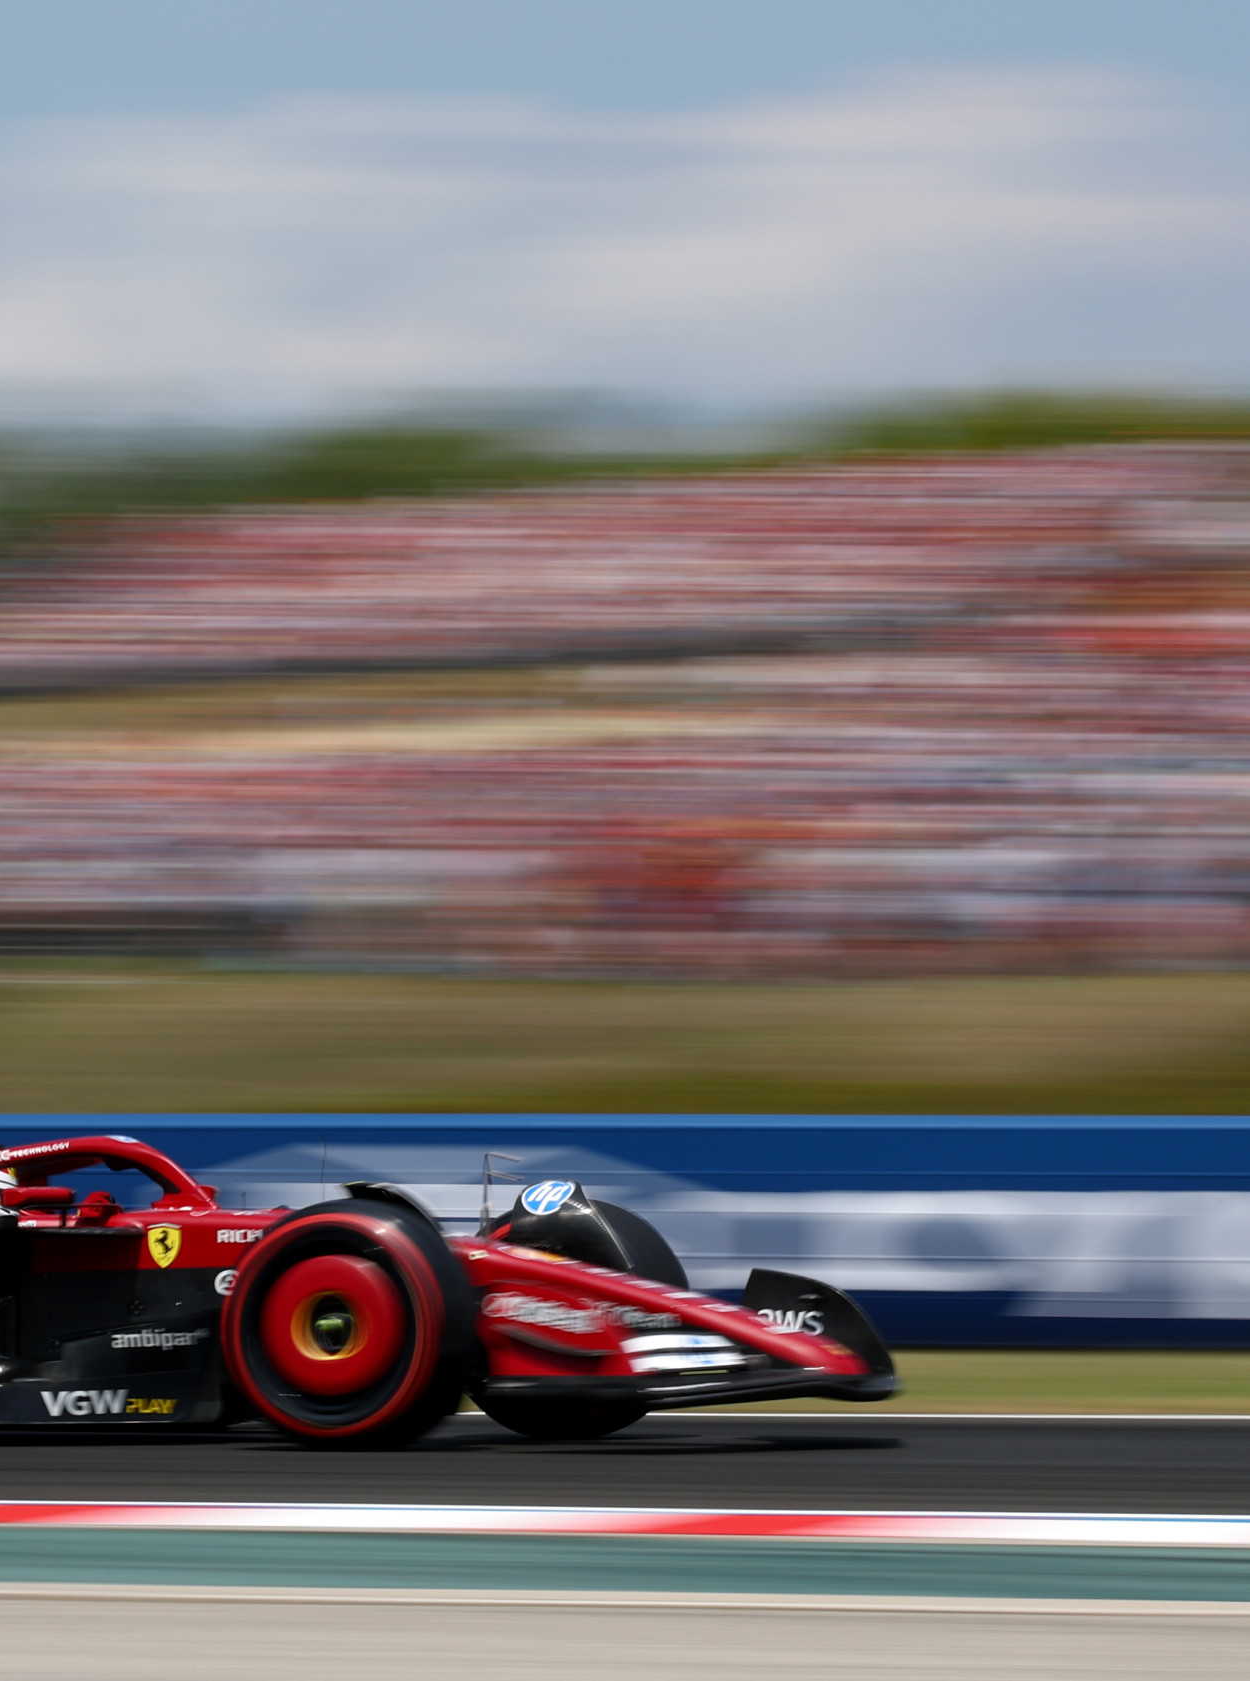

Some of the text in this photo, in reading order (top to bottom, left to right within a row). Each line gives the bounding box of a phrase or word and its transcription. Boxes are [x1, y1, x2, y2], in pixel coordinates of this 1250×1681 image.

[10, 1142, 70, 1158] TECHNOLOGY
[526, 1181, 570, 1214] hp
[40, 1388, 178, 1417] VGW PLAY
